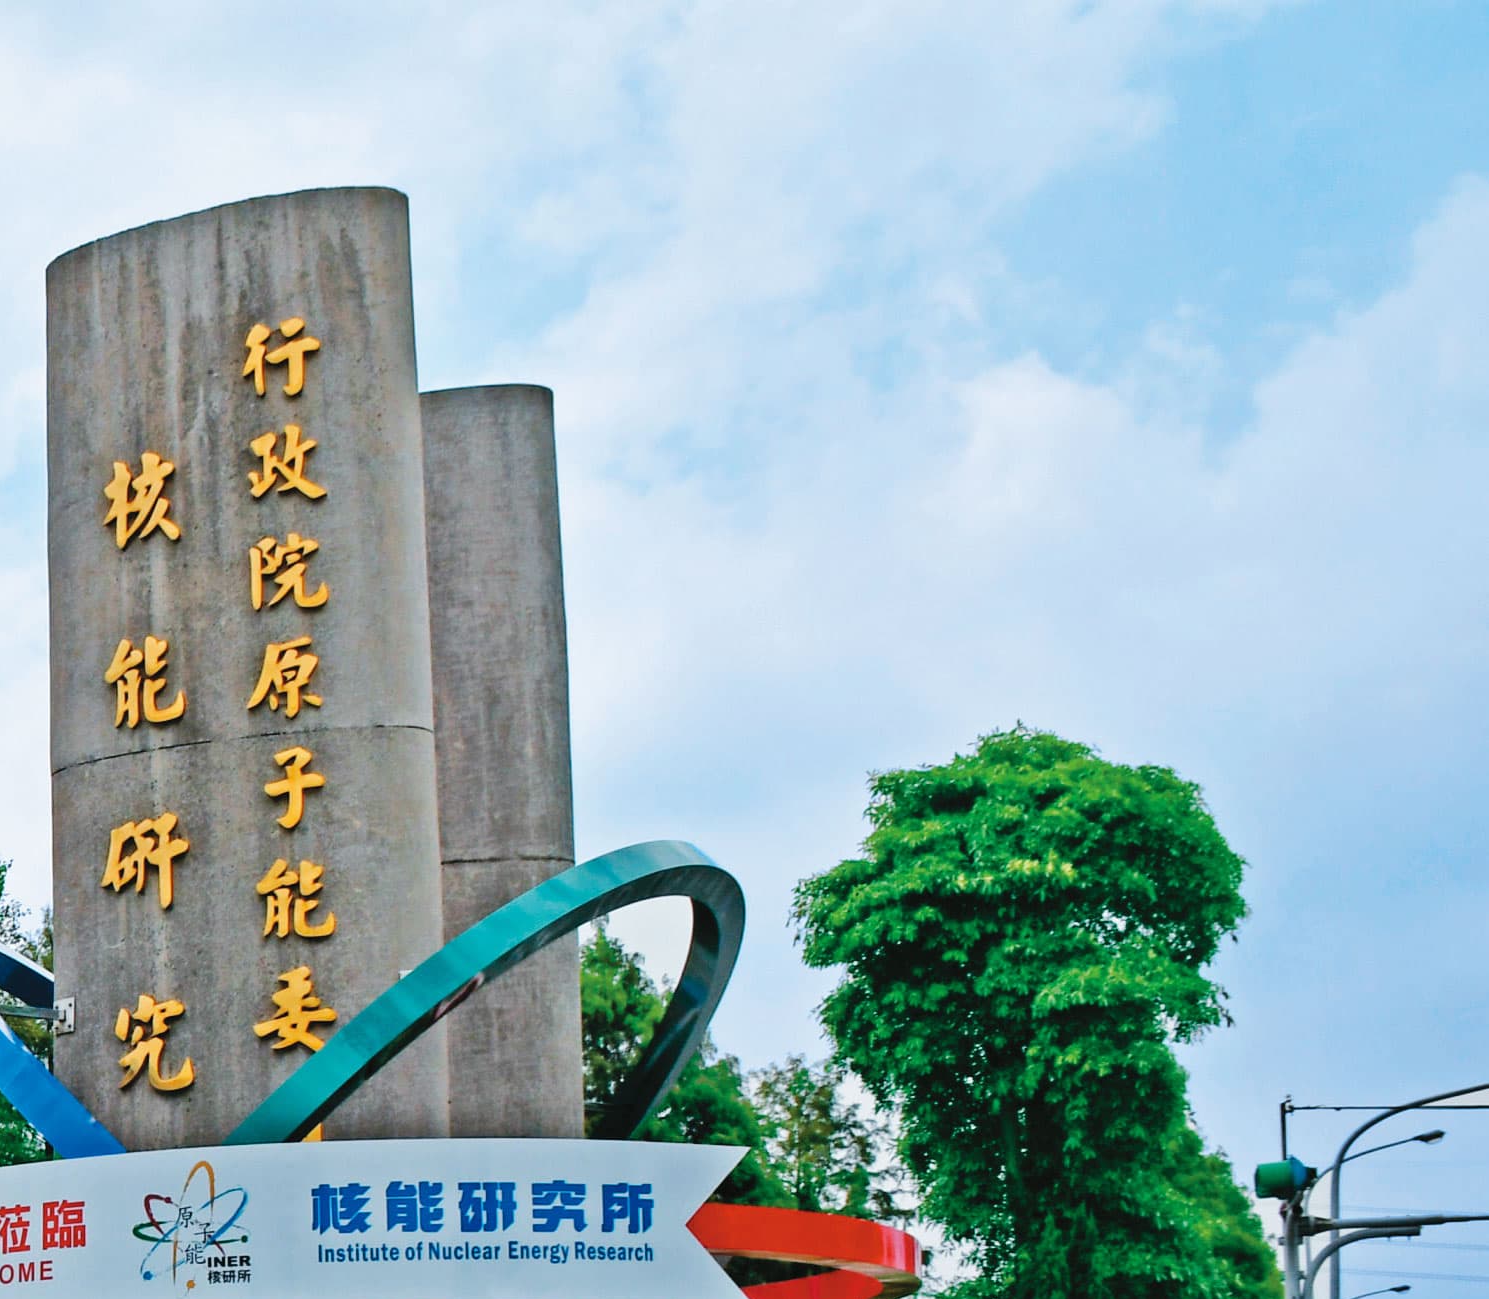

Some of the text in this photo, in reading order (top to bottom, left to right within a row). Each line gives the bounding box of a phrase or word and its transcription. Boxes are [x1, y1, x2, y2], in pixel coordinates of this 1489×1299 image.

[241, 317, 338, 1142] 行政院原子能委
[101, 450, 195, 1092] 核能研究
[311, 1180, 655, 1235] 核能研究所
[207, 1255, 251, 1268] INER
[318, 1240, 654, 1265] Institute of Nuclear Energy Research
[208, 1269, 251, 1285] 核研所
